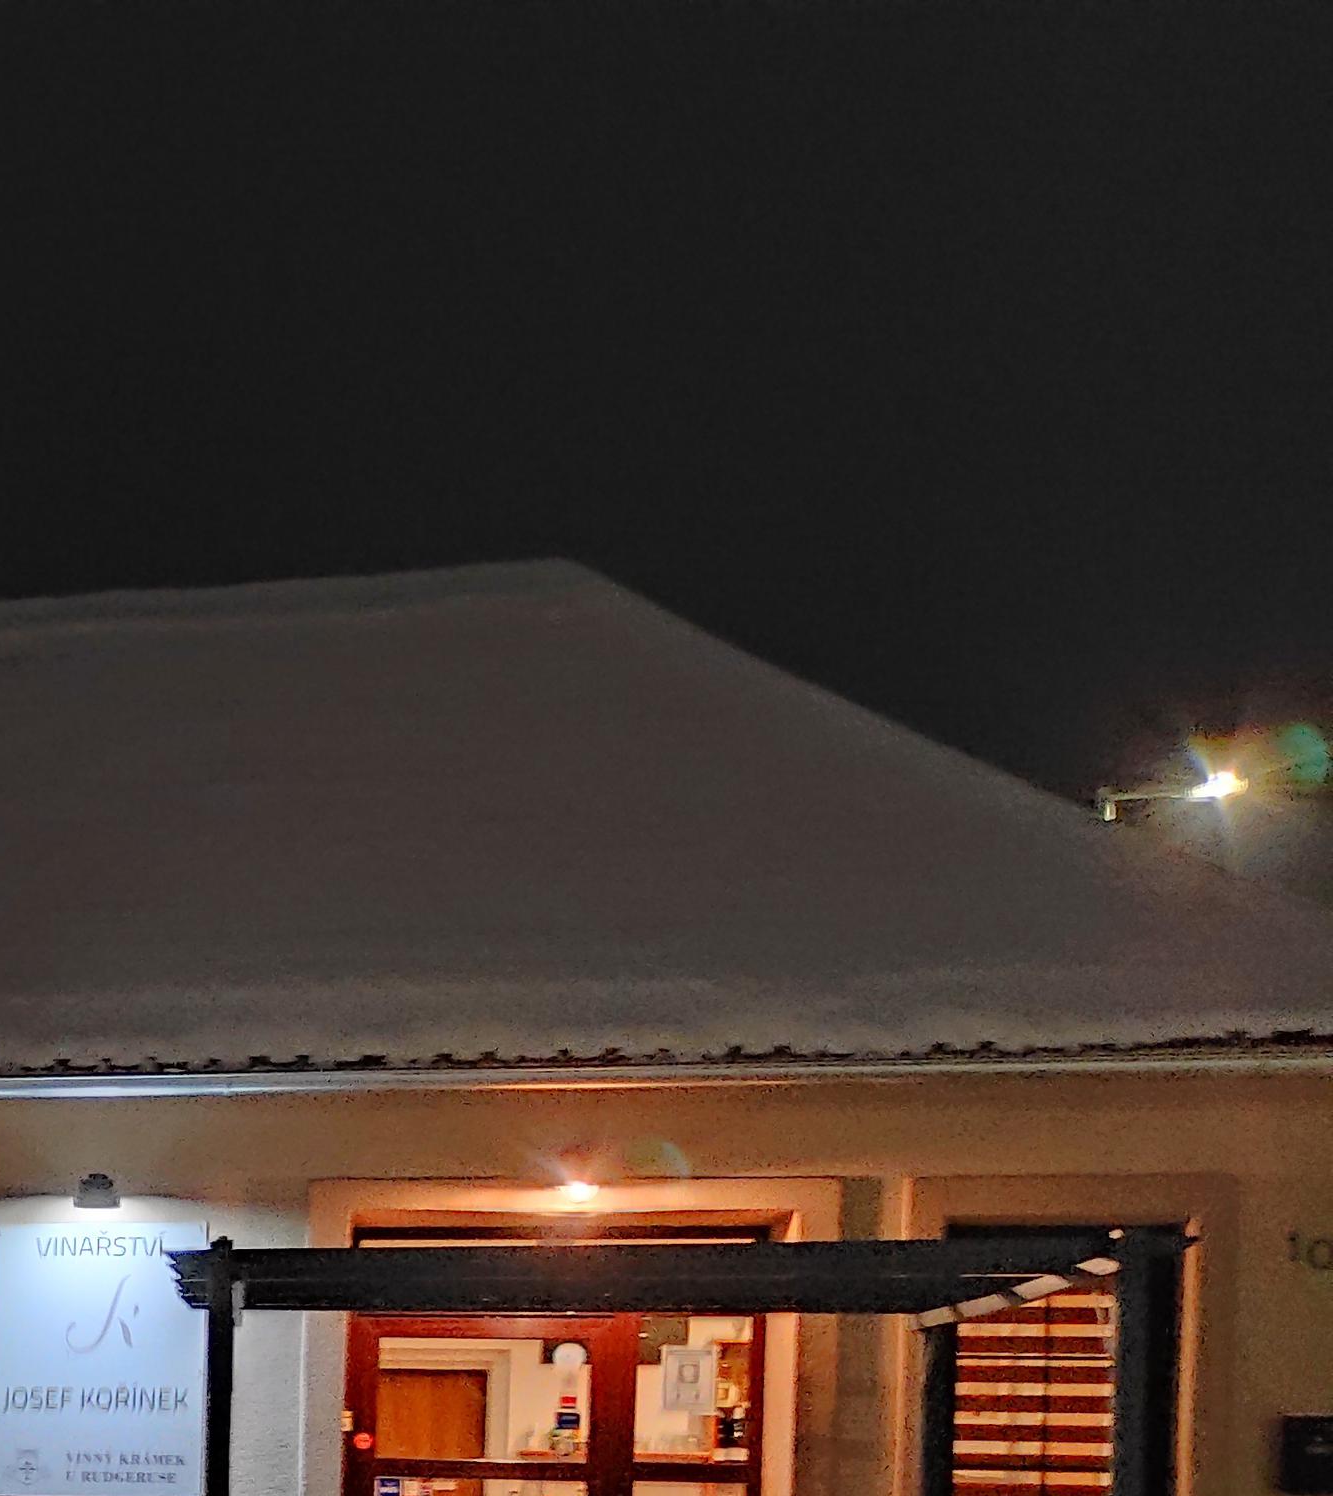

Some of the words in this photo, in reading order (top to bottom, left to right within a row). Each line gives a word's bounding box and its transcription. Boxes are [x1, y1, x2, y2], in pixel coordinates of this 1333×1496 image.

[36, 1229, 167, 1258] VINAŘSTVÍ
[3, 1386, 73, 1413] JOSEF
[80, 1380, 189, 1413] KOŘÍNEK
[118, 1450, 186, 1466] KRÁMEK
